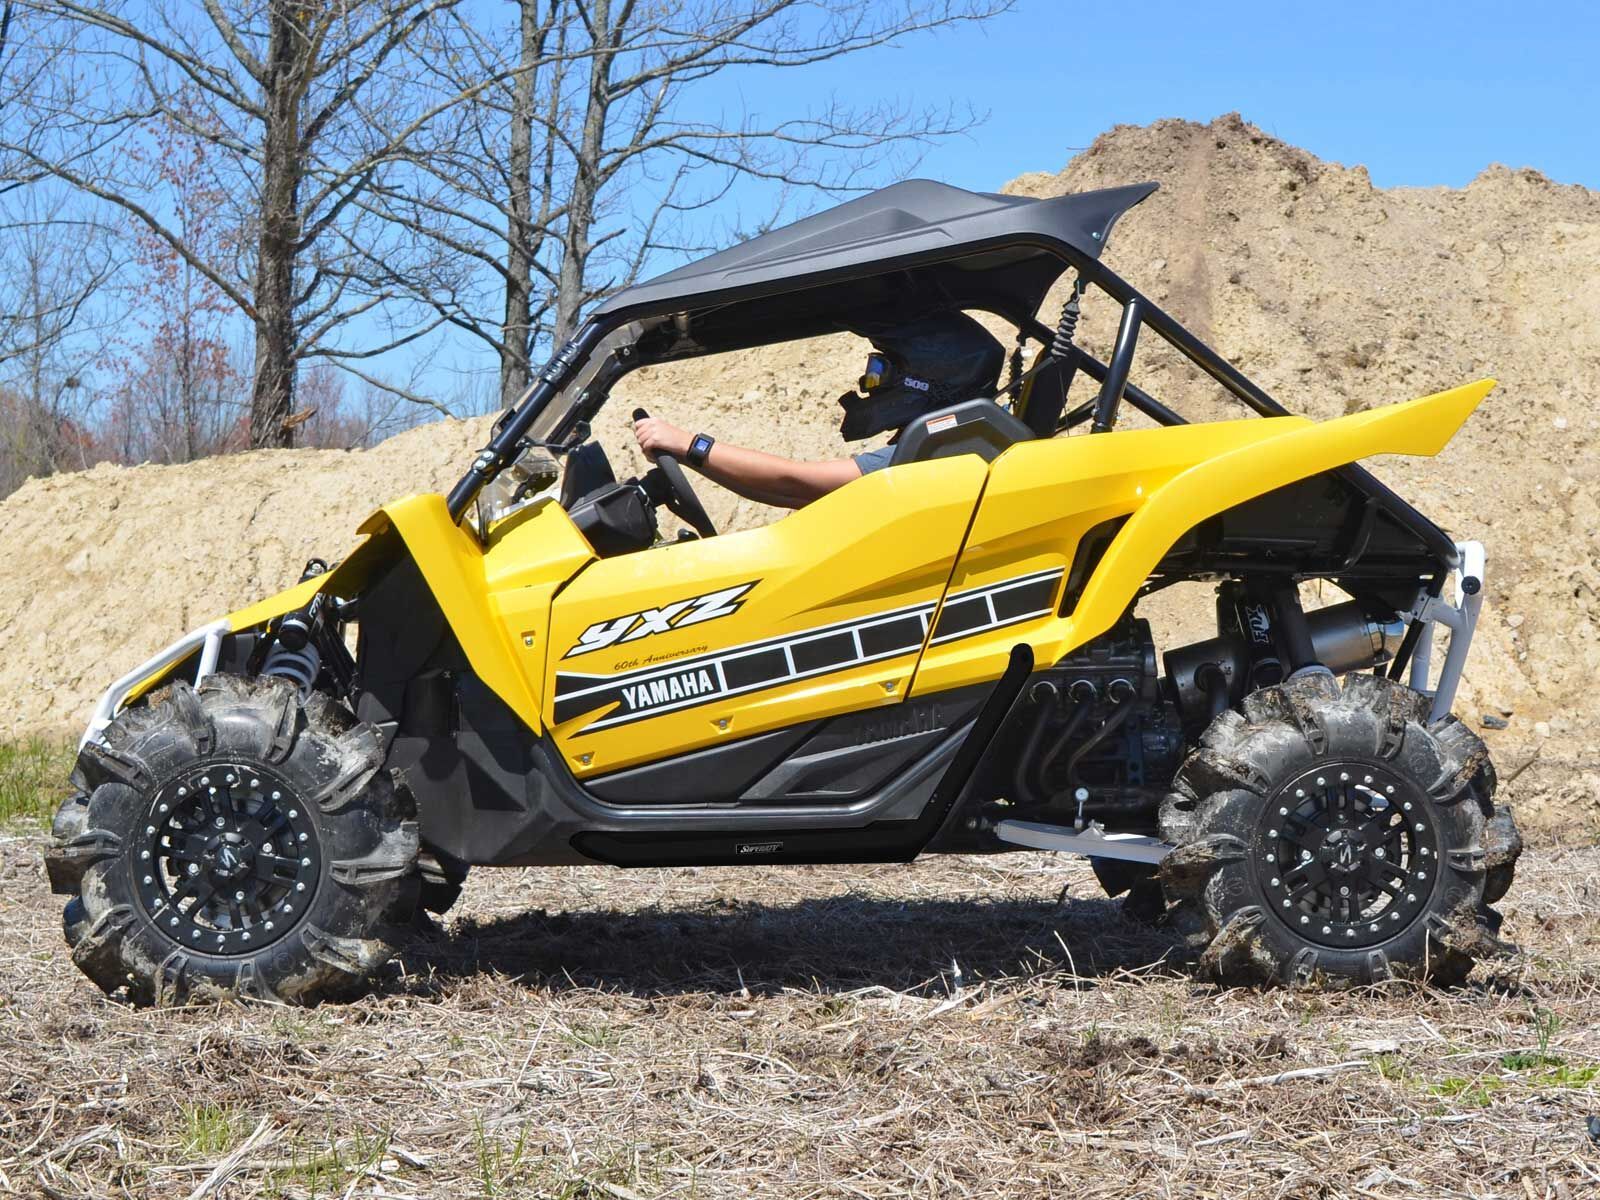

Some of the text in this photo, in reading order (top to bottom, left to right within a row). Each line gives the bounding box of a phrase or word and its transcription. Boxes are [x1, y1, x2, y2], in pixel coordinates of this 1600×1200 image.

[904, 377, 929, 391] 509
[613, 645, 708, 671] 60th Anniversary
[621, 669, 714, 710] YAMAHA
